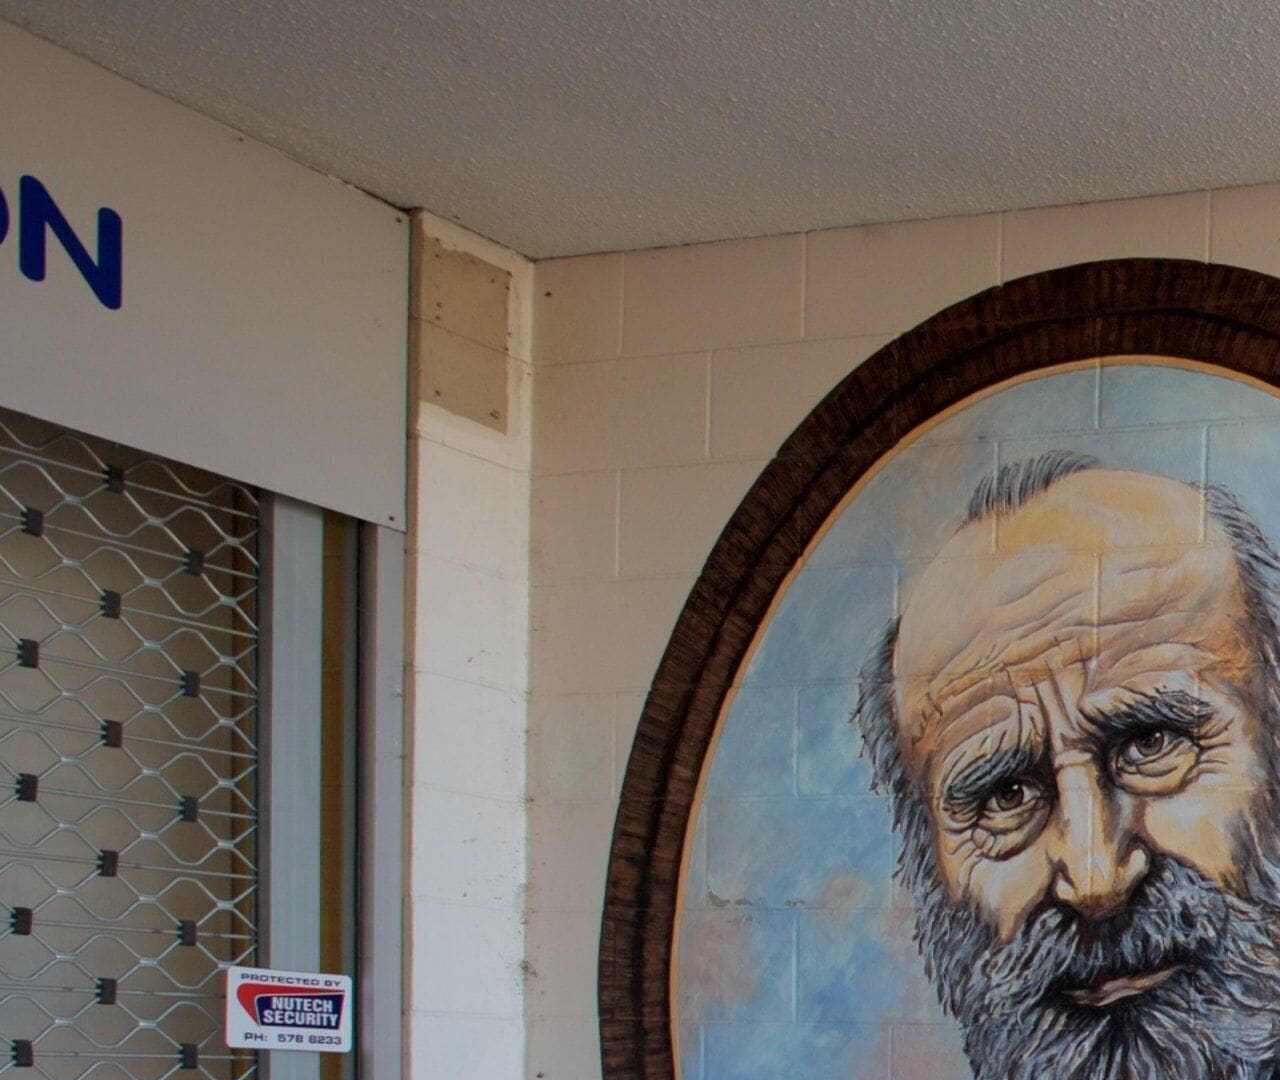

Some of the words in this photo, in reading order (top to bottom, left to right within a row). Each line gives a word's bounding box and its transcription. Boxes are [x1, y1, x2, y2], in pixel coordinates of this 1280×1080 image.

[240, 973, 320, 986] PROTECTED
[272, 997, 333, 1013] NUTECH
[263, 1010, 339, 1026] SECURITY
[244, 1032, 268, 1041] PH:
